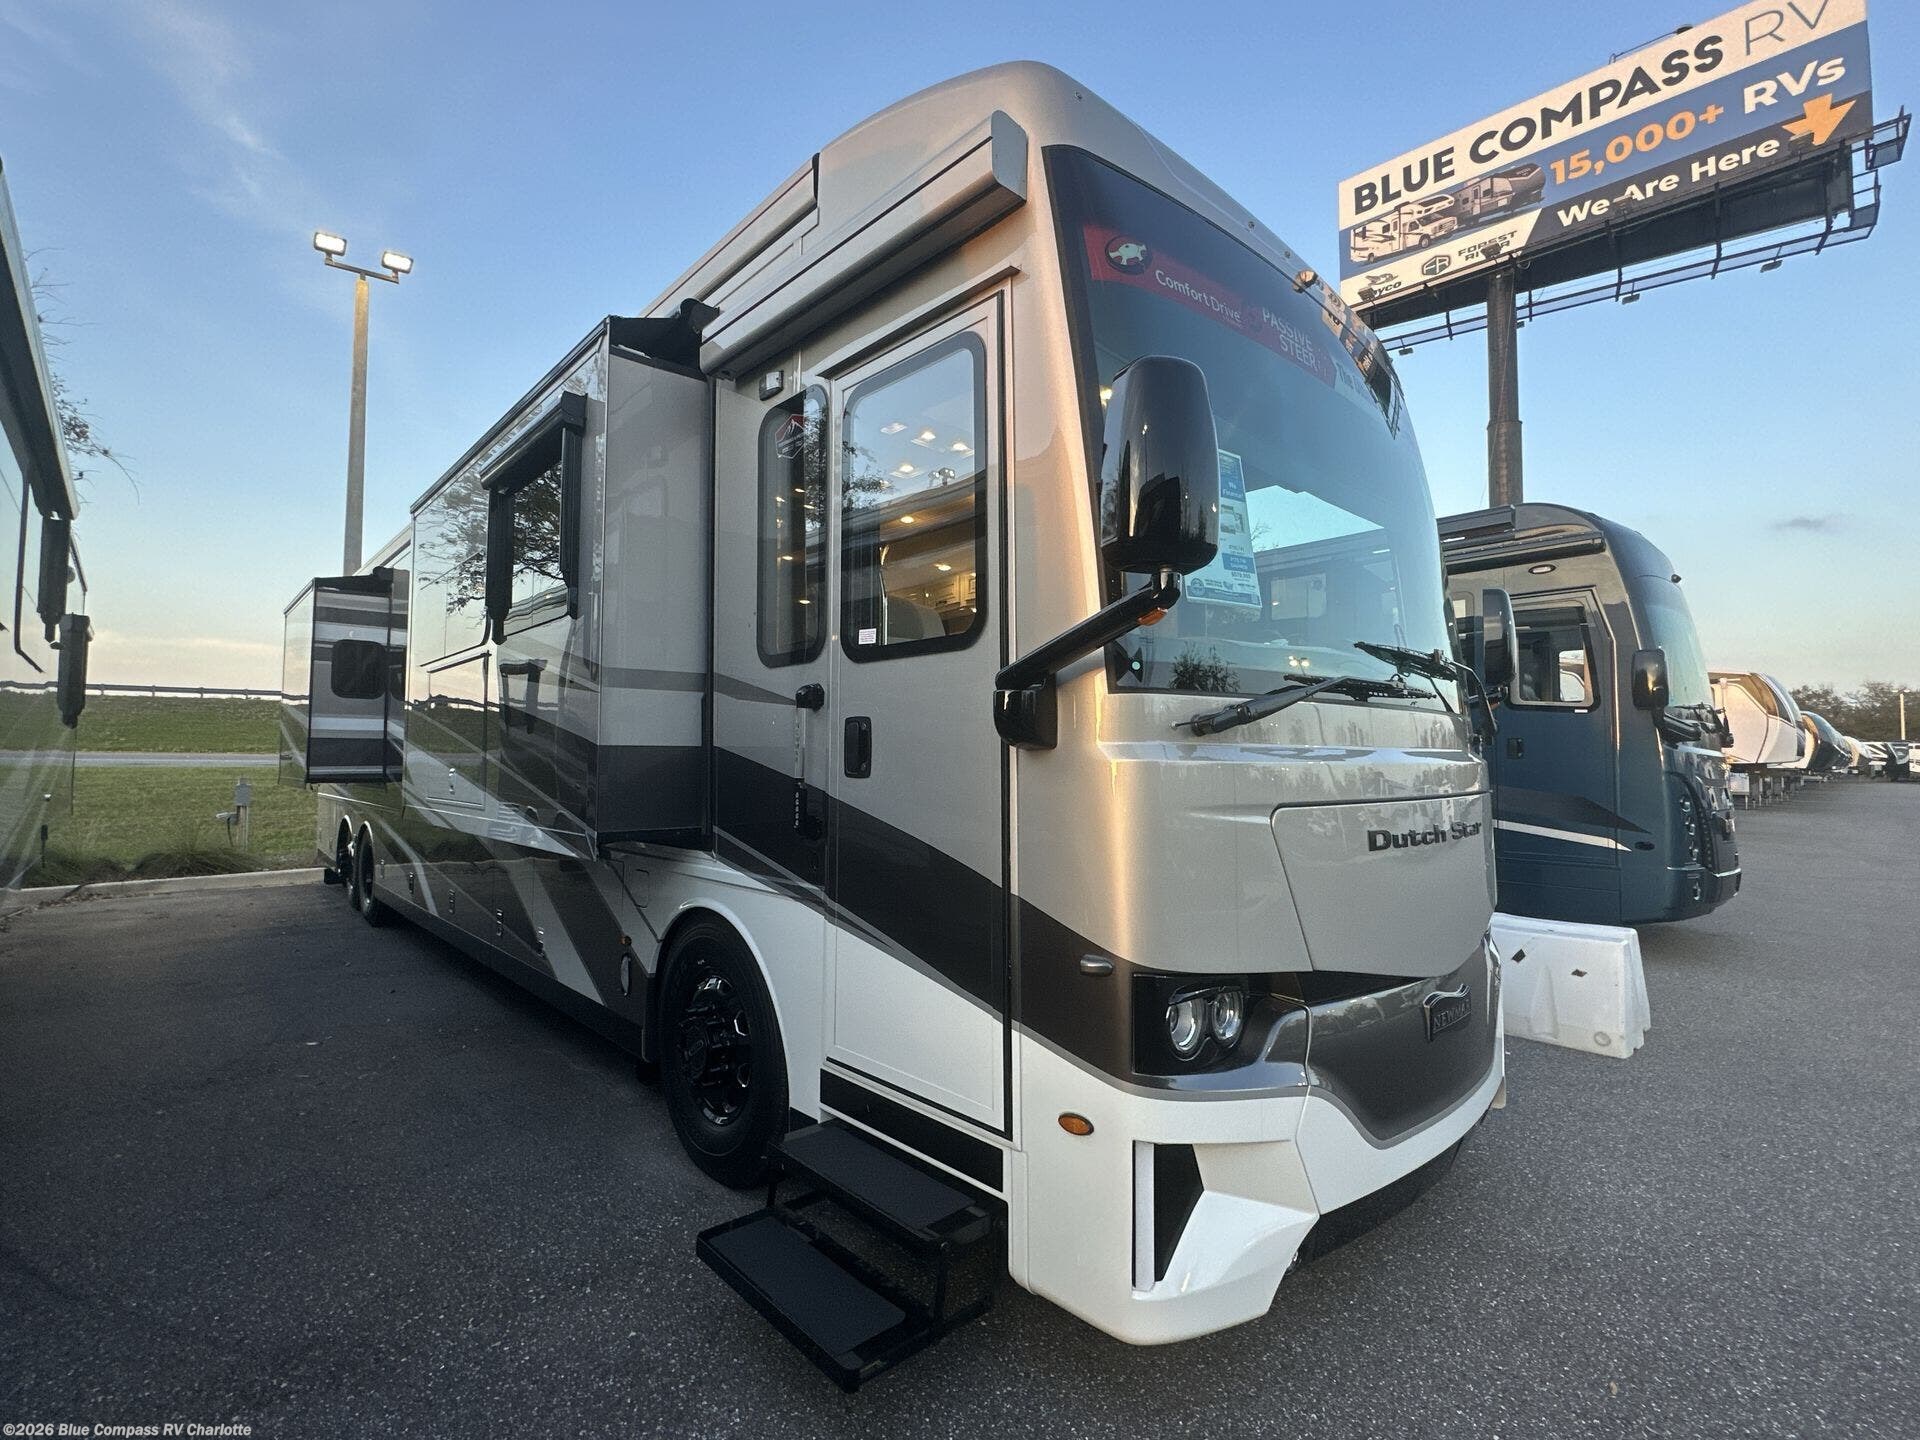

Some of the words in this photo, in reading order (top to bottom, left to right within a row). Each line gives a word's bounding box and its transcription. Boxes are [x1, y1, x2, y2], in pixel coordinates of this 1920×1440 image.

[1354, 147, 1455, 216] BLUE
[1469, 35, 1723, 164] COMPASS
[1745, 0, 1829, 56] RV
[1550, 104, 1724, 185] 15,000+
[1743, 57, 1846, 114] RVs
[1557, 199, 1610, 227] We
[1622, 174, 1680, 202] Are
[1691, 138, 1780, 183] Here
[1465, 240, 1510, 261] RIR
[1367, 824, 1447, 851] Dutch
[1451, 821, 1482, 840] Star
